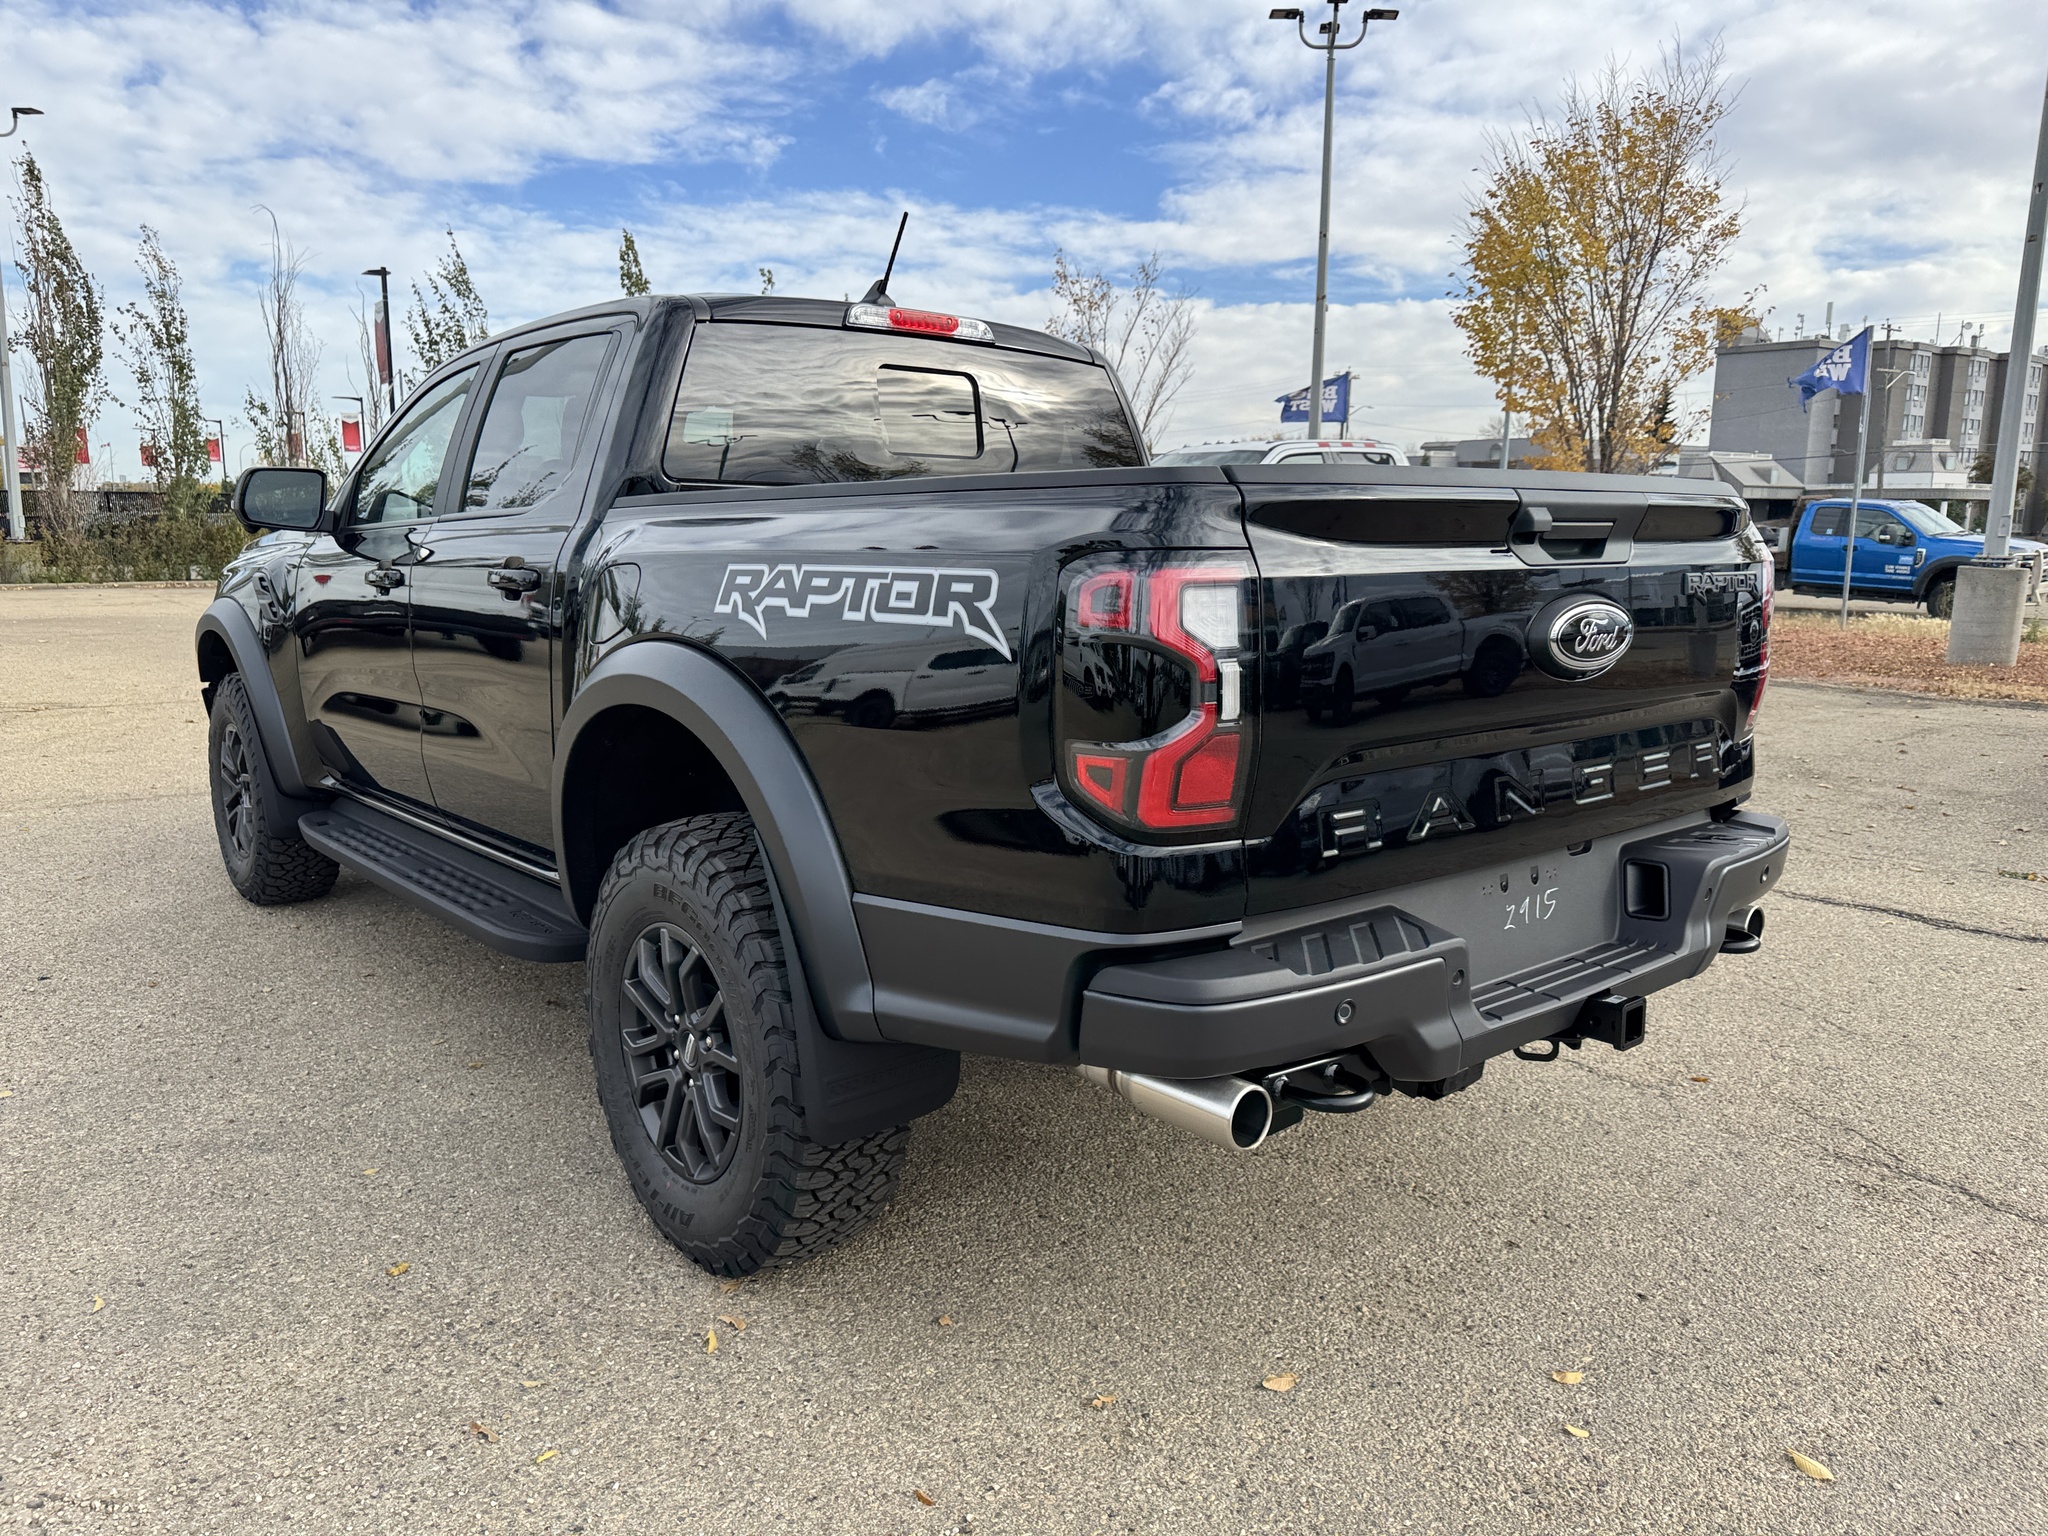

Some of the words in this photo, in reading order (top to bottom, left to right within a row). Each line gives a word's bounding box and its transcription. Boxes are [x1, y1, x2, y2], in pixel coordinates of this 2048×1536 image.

[714, 563, 1013, 662] RAPTOR
[1681, 571, 1762, 606] RAPTOR
[1574, 618, 1619, 654] Ford
[1318, 738, 1721, 859] RANGER
